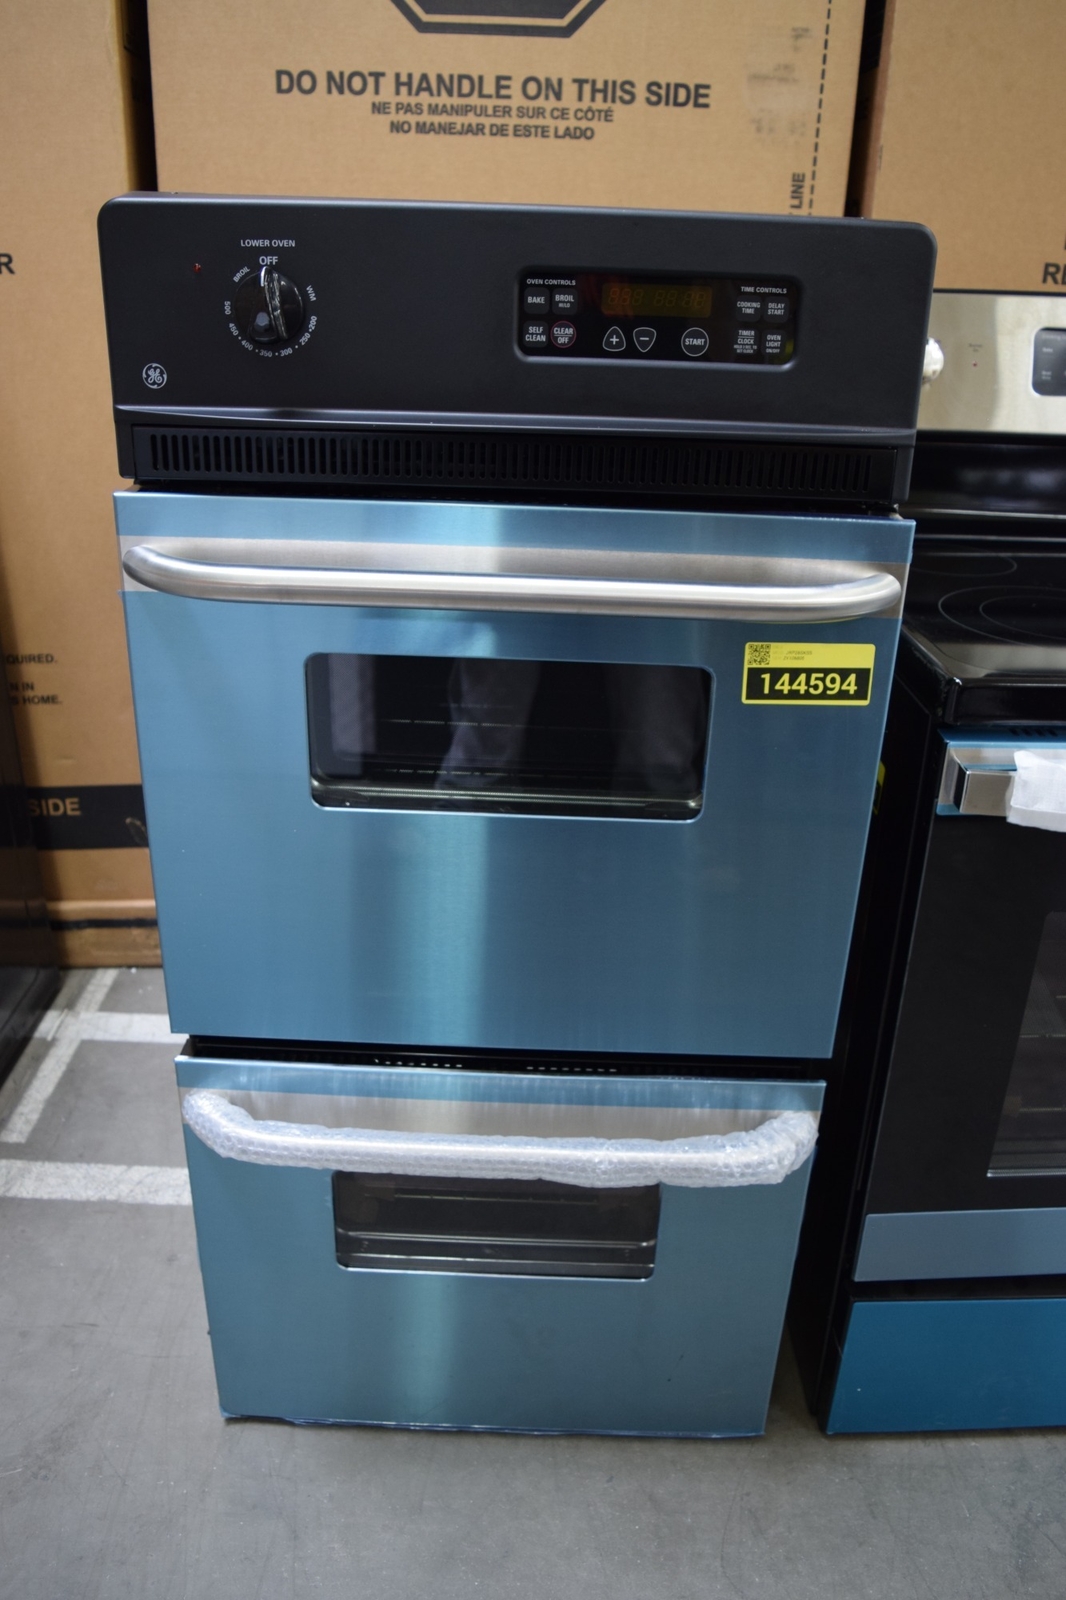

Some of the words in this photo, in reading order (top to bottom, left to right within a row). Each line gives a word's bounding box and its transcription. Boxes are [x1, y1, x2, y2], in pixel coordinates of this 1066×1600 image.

[275, 69, 317, 95] DO
[326, 70, 386, 96] NOT
[394, 72, 512, 99] HANDLE
[521, 75, 563, 101] ON
[572, 78, 637, 105] THIS
[645, 81, 711, 108] SIDE
[371, 101, 391, 115] NE
[395, 102, 424, 116] PAS
[427, 103, 512, 118] MANIPULER
[516, 105, 546, 119] SUR
[550, 107, 570, 120] CE
[390, 120, 411, 134] NO
[415, 121, 486, 136] MANEJAR
[489, 123, 509, 137] DE
[513, 124, 550, 138] ESTE
[554, 126, 595, 140] LADO
[790, 172, 806, 209] LINE
[240, 239, 270, 247] LOWER
[271, 239, 296, 248] OVEN
[259, 256, 278, 265] OFF
[233, 266, 250, 283] BROIL
[527, 296, 545, 304] BAKE
[555, 294, 574, 302] BROIL
[309, 315, 318, 330] 200
[229, 322, 239, 336] 450
[528, 326, 543, 334] SELF
[553, 327, 574, 335] CLEAR
[299, 332, 311, 346] 250
[525, 334, 546, 342] CLEAN
[557, 336, 569, 344] OFF
[685, 338, 706, 346] START
[241, 339, 254, 352] 400
[259, 348, 273, 358] 350
[280, 347, 293, 357] 300
[22, 682, 34, 692] IN
[760, 673, 858, 695] 144594
[22, 695, 62, 705] HOME.
[28, 797, 81, 817] SIDE
